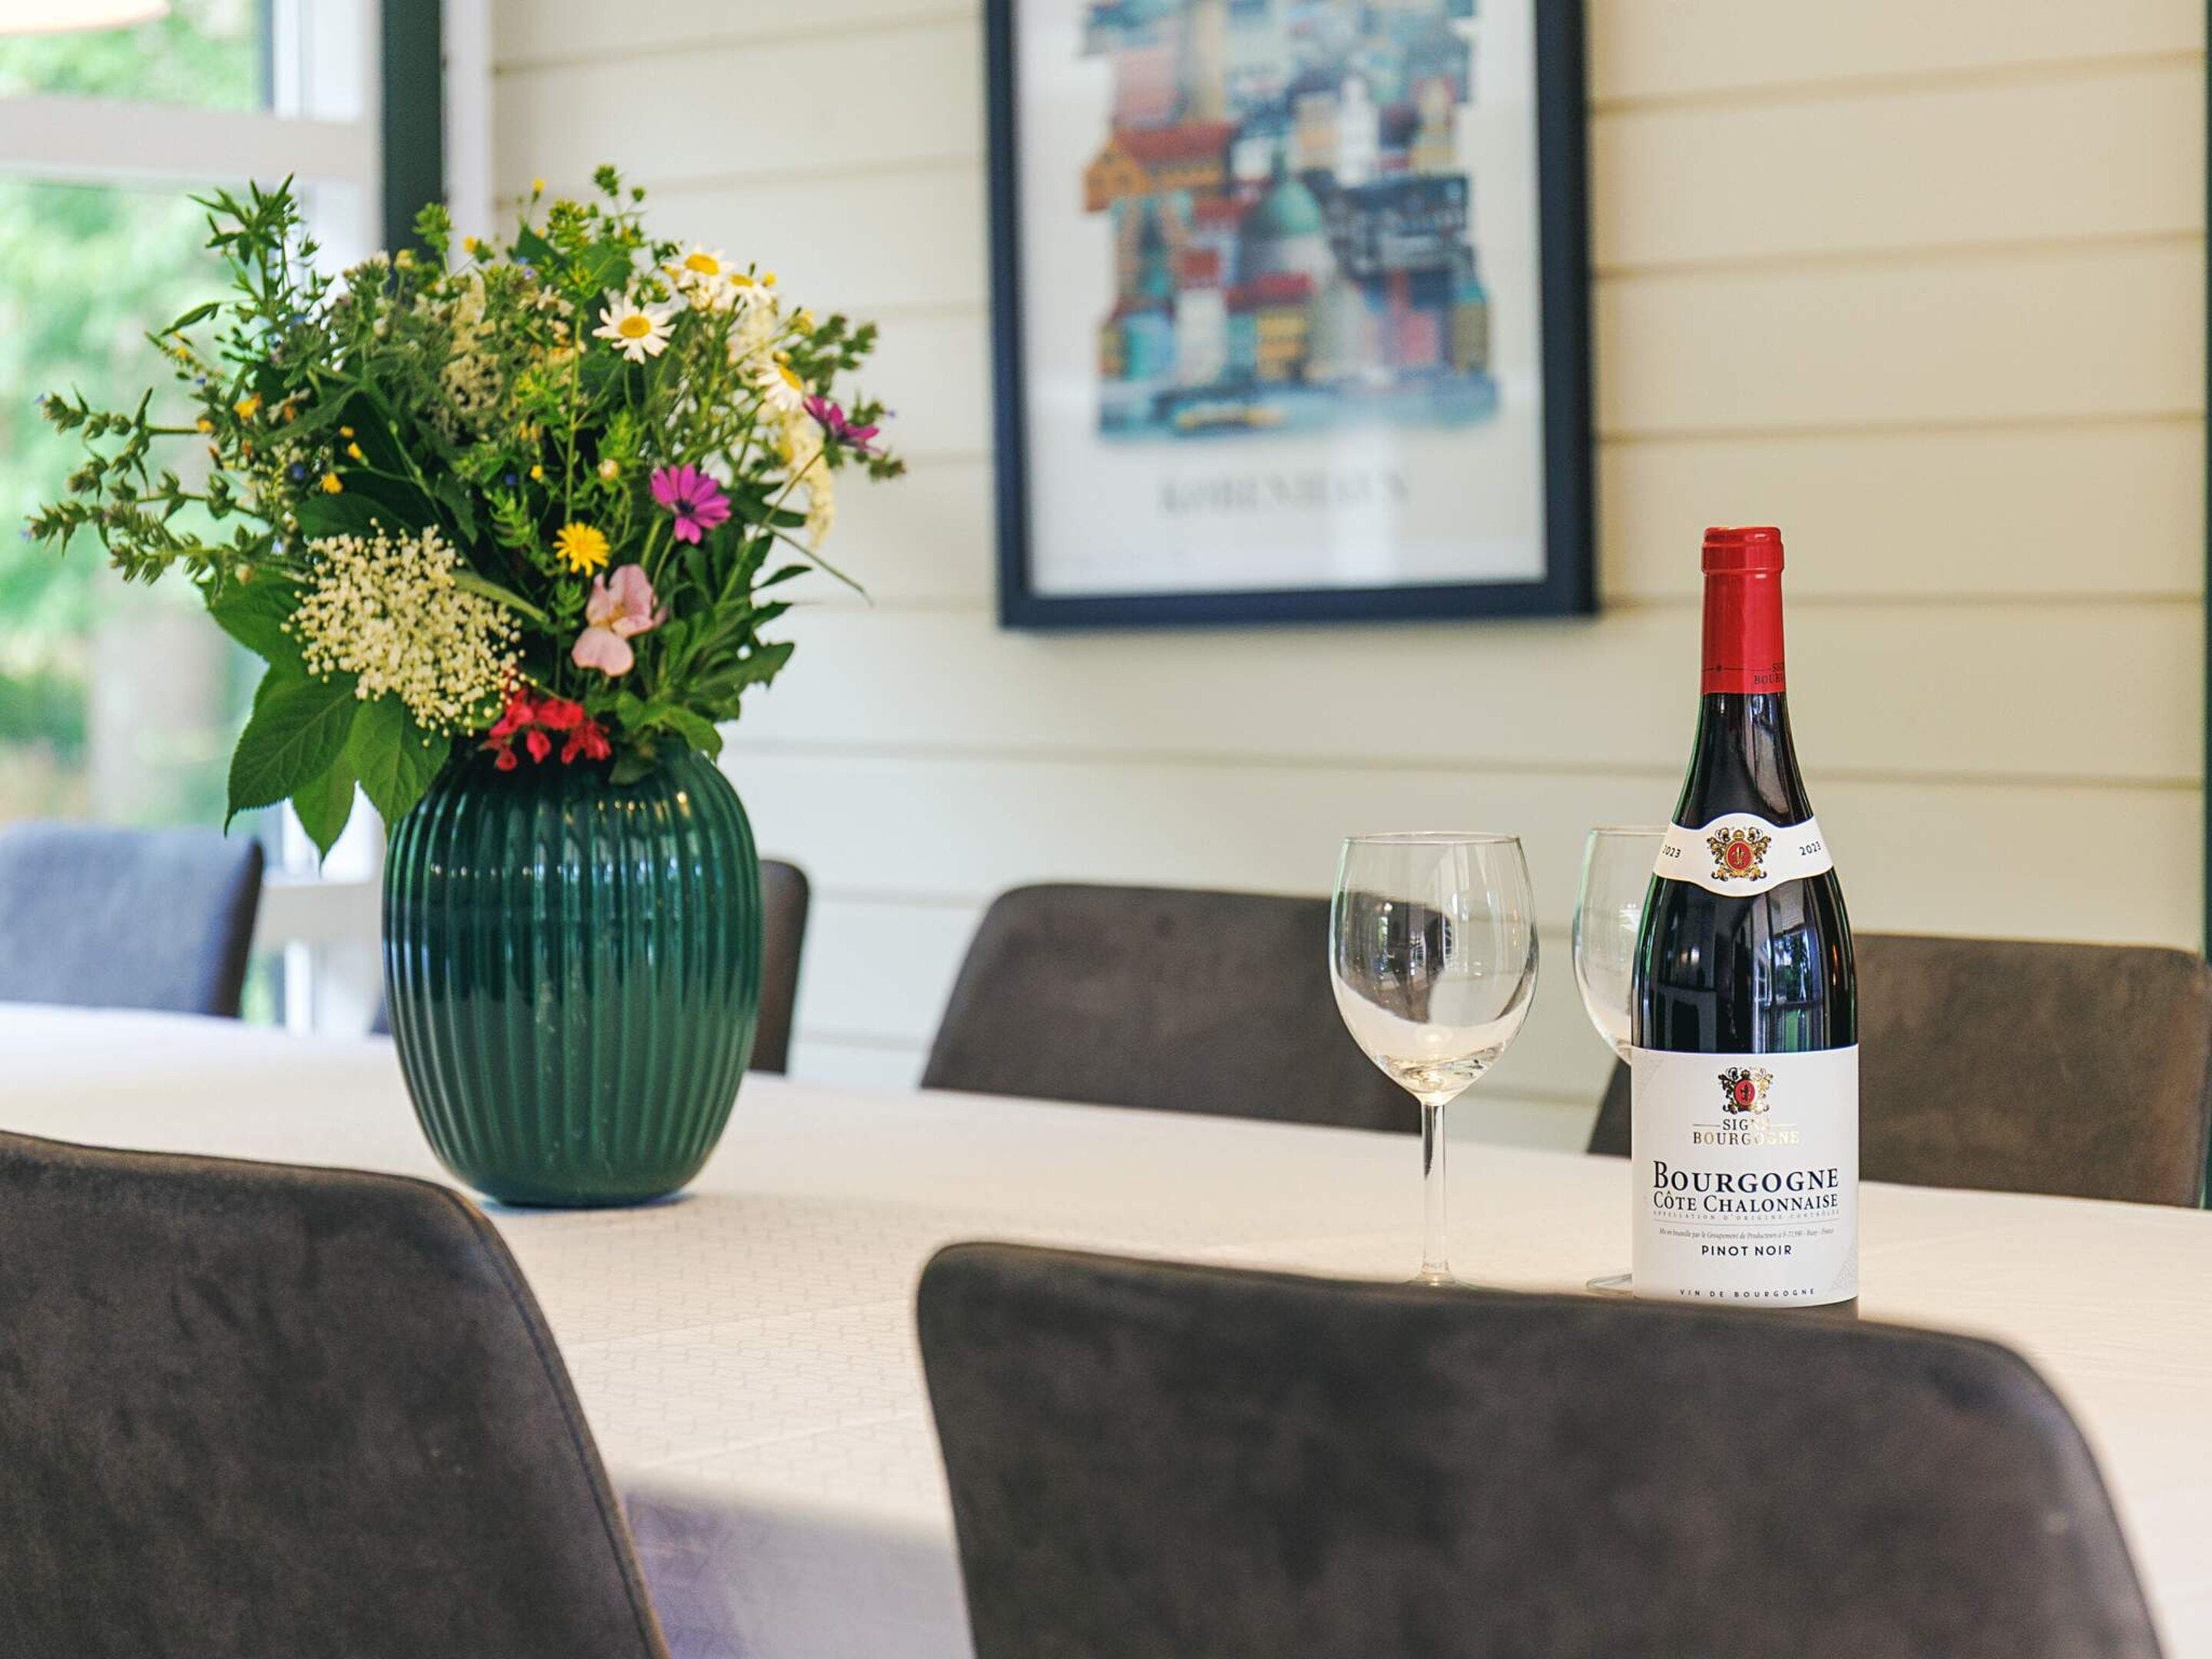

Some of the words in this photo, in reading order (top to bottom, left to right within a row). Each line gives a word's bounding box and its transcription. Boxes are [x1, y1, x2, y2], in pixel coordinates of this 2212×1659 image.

[1799, 841, 1822, 856] 2023
[1654, 1161, 1839, 1193] BOURGOGNE
[1654, 1190, 1697, 1210] CÔTE
[1704, 1194, 1838, 1213] CHALONNAISE
[1702, 1245, 1748, 1257] PINOT
[1755, 1245, 1792, 1256] NOIR
[1734, 1288, 1815, 1298] BOURGOGNE
